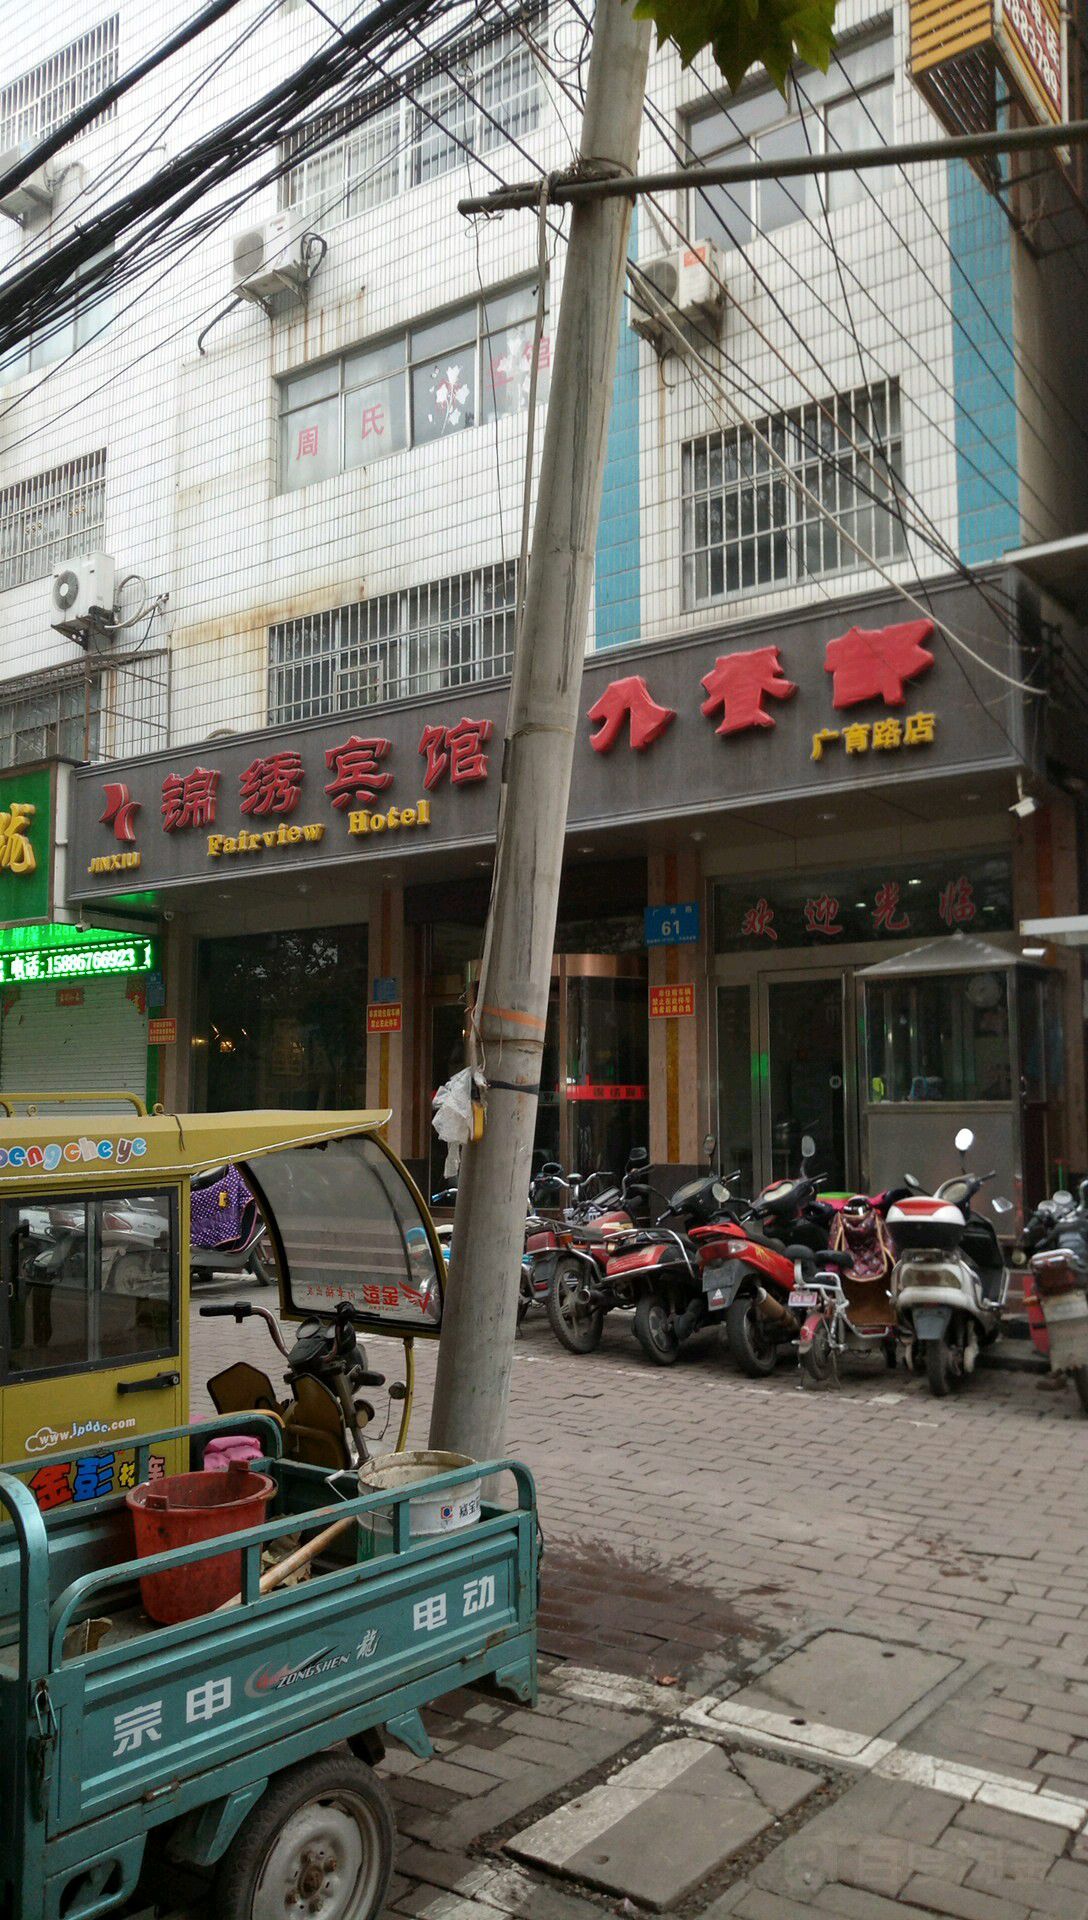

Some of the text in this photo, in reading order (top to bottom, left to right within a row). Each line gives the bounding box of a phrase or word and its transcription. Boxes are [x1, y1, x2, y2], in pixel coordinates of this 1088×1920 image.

[810, 712, 936, 761] 广育路店
[161, 716, 494, 832] 锦绣宾馆
[206, 799, 432, 857] Fairview Hotel
[87, 851, 142, 874] JINXIU
[661, 920, 680, 936] 61
[742, 876, 976, 941] 欢迎光临
[64, 1137, 113, 1162] che
[115, 1137, 147, 1164] ye
[412, 1574, 496, 1633] 电动
[276, 1654, 351, 1691] ZONGSHEN
[112, 1676, 232, 1757] 宗申
